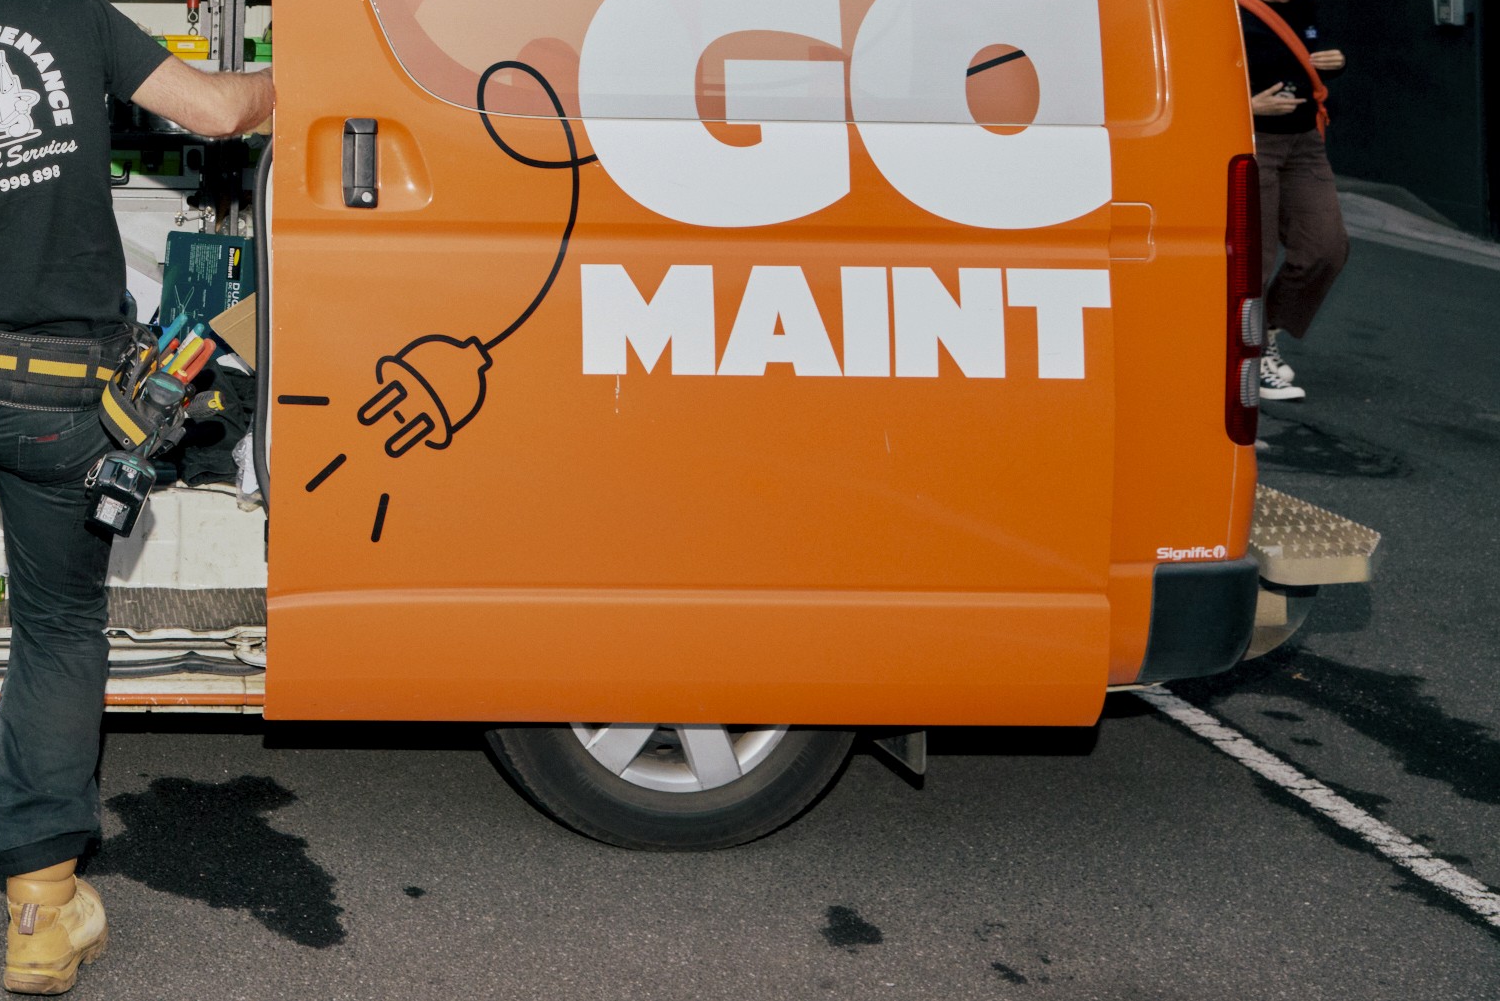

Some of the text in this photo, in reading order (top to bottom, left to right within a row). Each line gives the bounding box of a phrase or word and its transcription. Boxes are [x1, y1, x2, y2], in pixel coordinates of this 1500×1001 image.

[6, 139, 78, 168] Services
[0, 173, 30, 192] 998
[32, 165, 61, 183] 898
[227, 247, 235, 279] Brilliant
[580, 263, 1111, 380] MAINT
